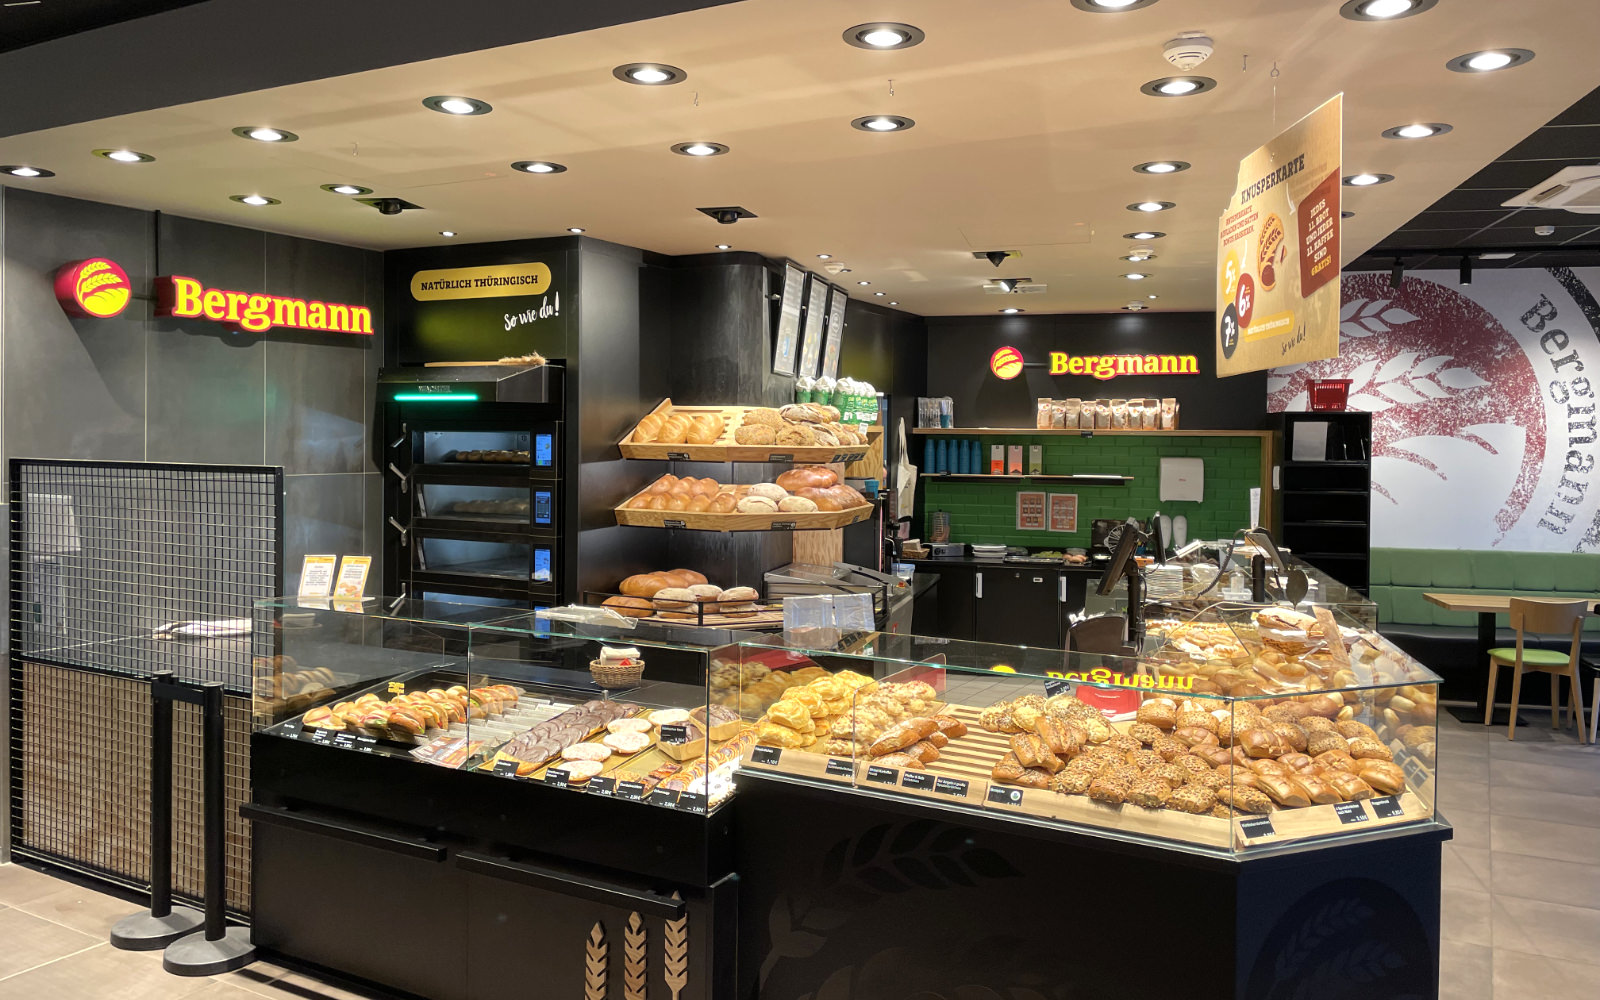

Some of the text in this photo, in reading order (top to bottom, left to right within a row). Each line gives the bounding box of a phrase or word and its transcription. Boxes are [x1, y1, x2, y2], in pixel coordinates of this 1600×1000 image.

[1241, 153, 1305, 205] KNUSPERKARTE
[1310, 198, 1326, 219] JEDES
[1315, 207, 1330, 227] BROT
[1313, 228, 1334, 251] KAFFEE
[1313, 246, 1328, 263] SIND
[421, 274, 539, 291] NATÜRLICH THÜRINGISCH
[172, 276, 374, 336] Bergmann
[504, 290, 560, 331] So wie du!
[1050, 351, 1199, 379] Bergmann
[1519, 293, 1598, 535] Bergmann
